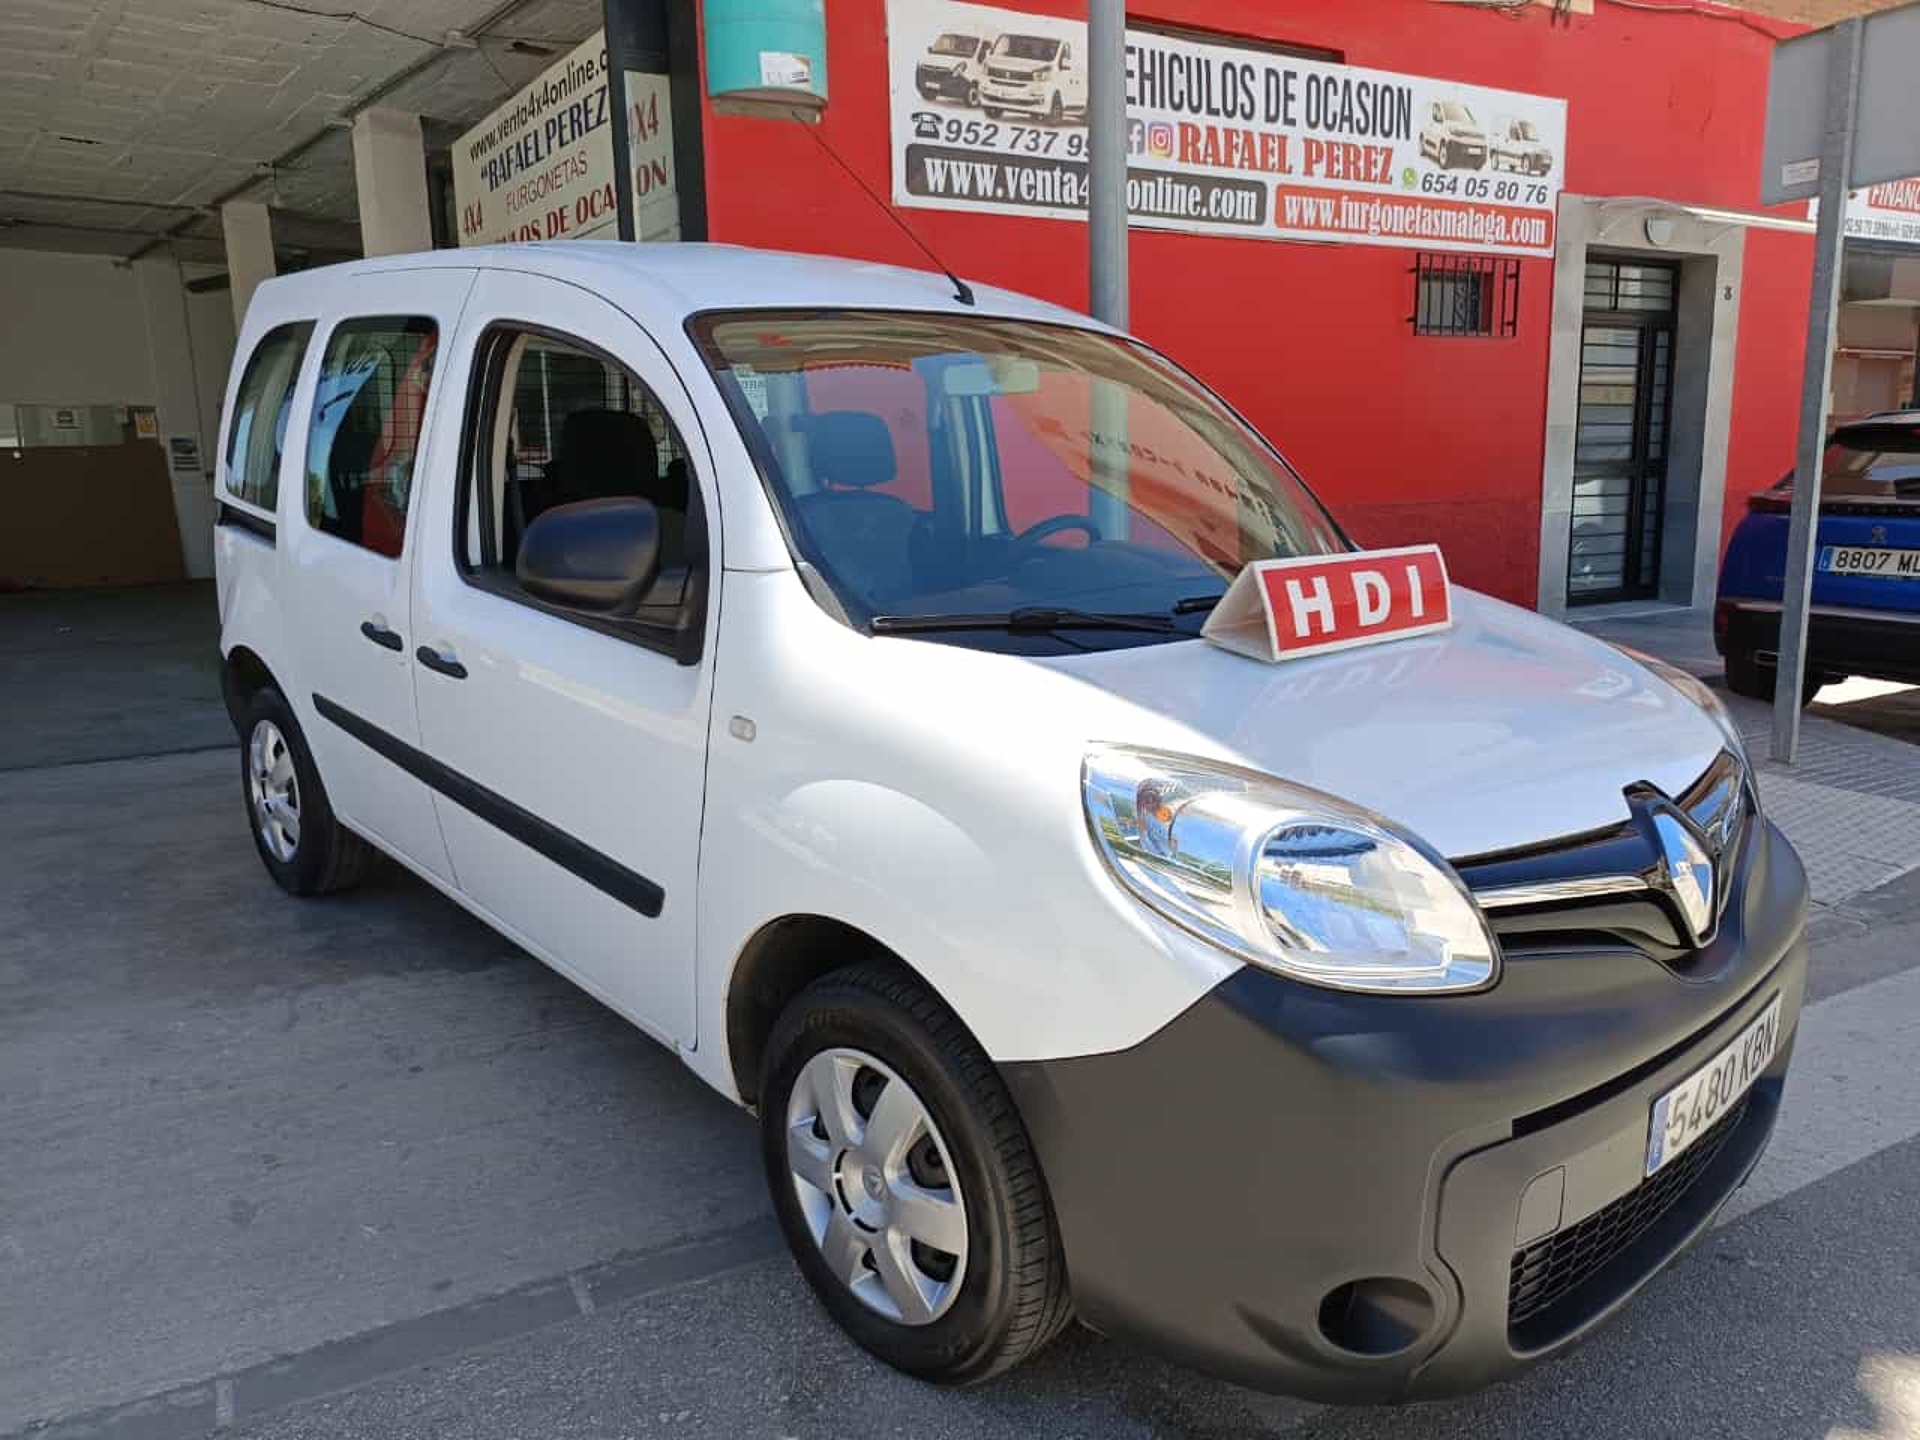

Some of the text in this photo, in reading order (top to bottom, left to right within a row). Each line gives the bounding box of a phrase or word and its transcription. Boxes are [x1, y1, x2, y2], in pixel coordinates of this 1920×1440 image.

[470, 49, 607, 164] www.venta4x4online.c
[545, 84, 608, 154] PEREZ
[634, 91, 659, 142] X4
[1125, 45, 1412, 140] EHICULOS DE OCASION
[945, 119, 1089, 157] 952 737 9
[1178, 121, 1394, 185] RAFAEL PEREZ
[505, 150, 588, 215] FURGONETAS
[1421, 172, 1549, 204] 654 05 80 76
[546, 205, 569, 239] DE
[1284, 194, 1546, 245] www.furgonetasmalaga.com
[1836, 550, 1892, 570] 8807
[1670, 1008, 1776, 1148] 5480 KBN
